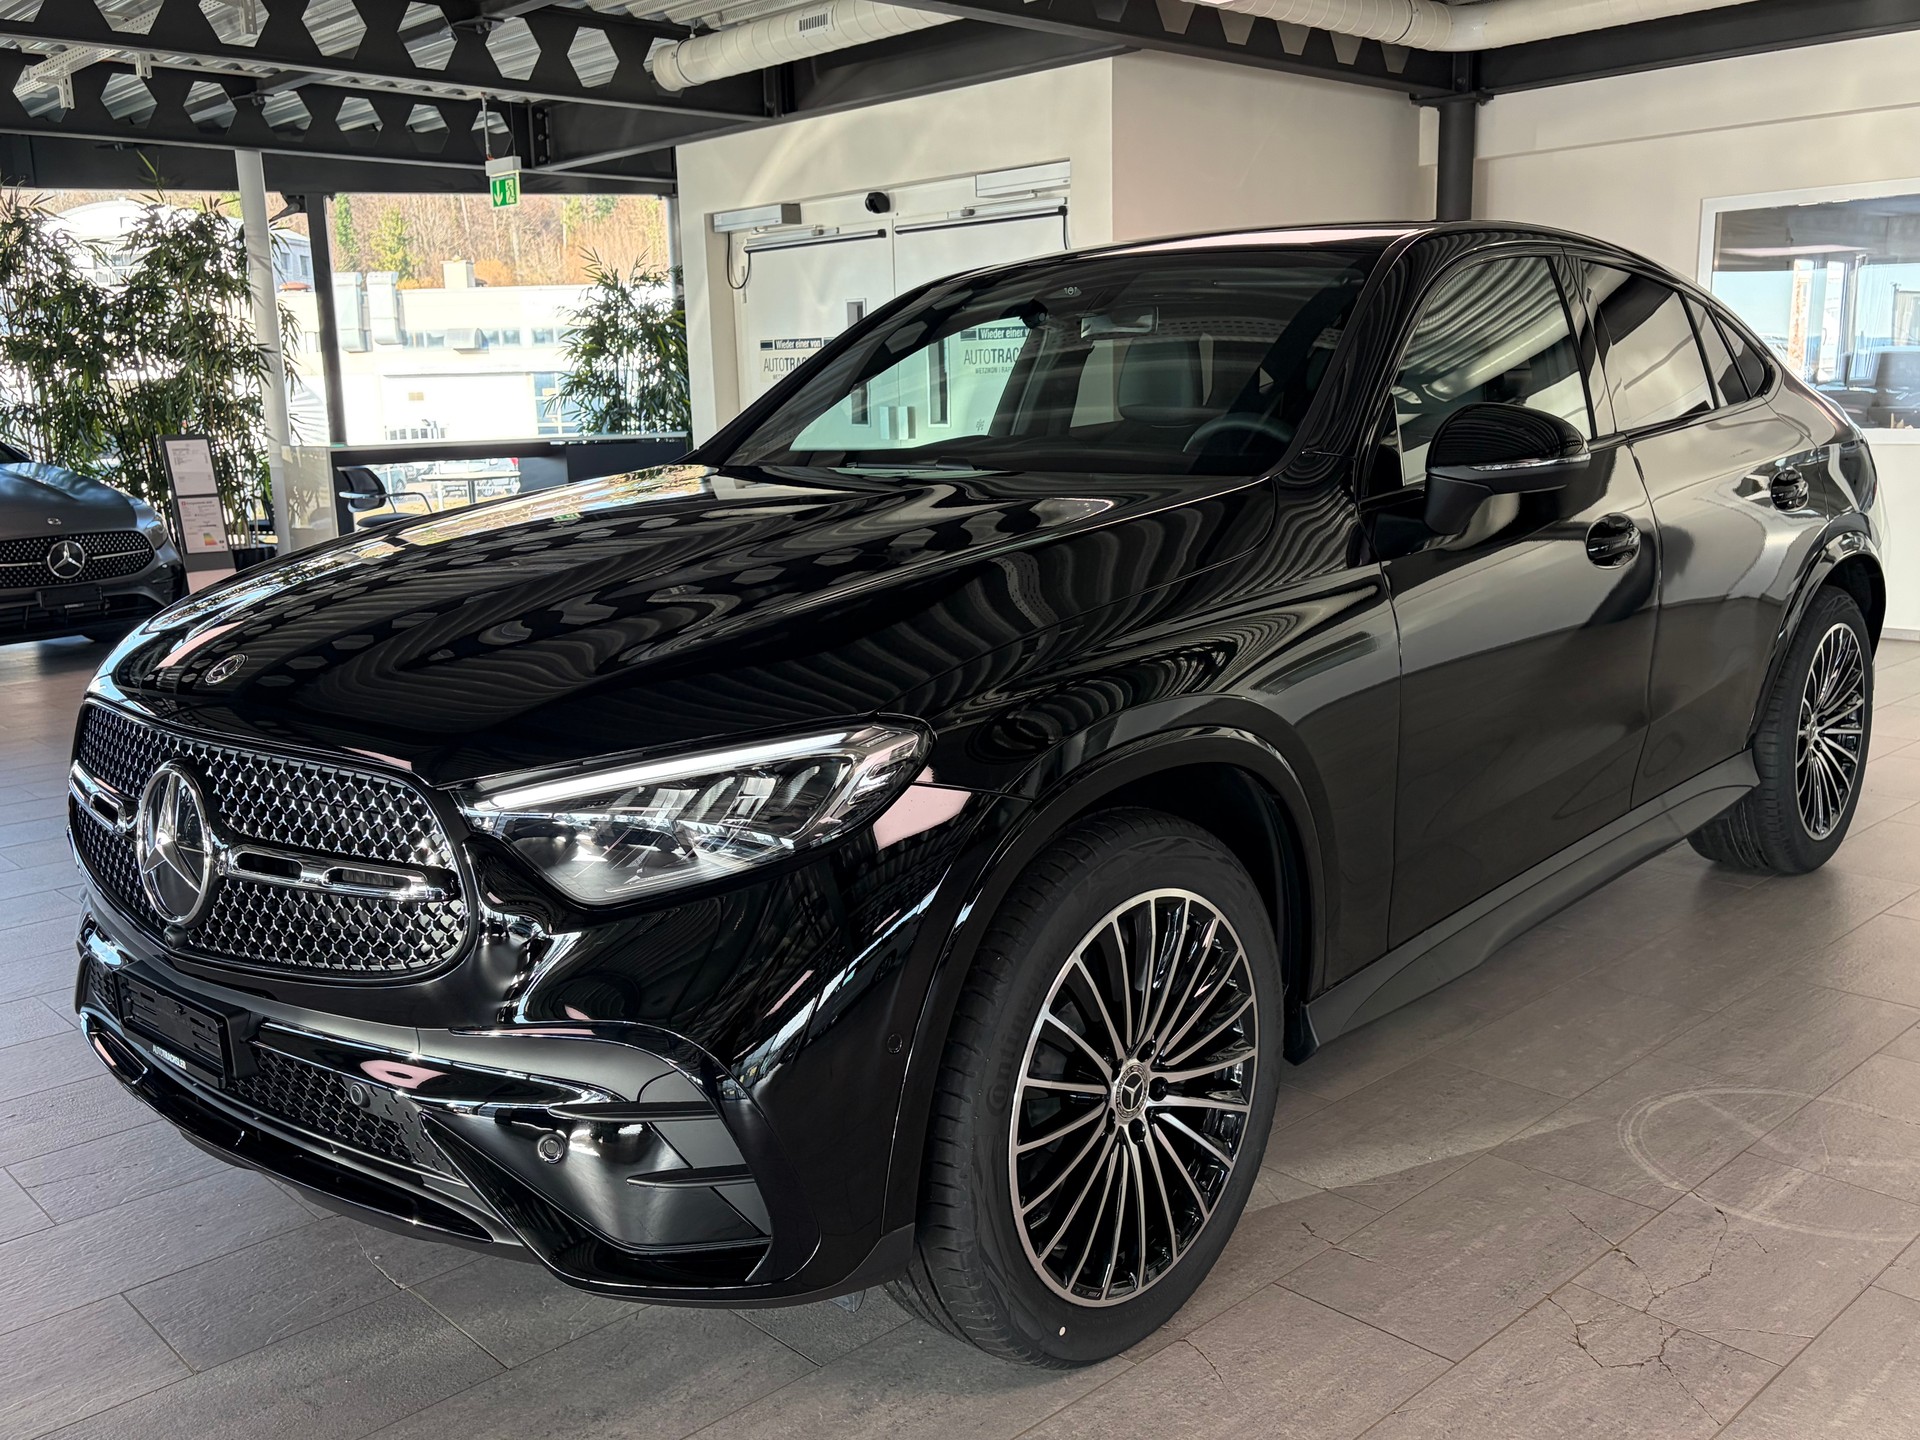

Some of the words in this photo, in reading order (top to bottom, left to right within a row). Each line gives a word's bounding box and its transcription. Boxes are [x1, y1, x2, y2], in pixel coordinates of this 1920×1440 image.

[980, 328, 1005, 339] Wieder
[1005, 327, 1023, 338] einer
[776, 340, 794, 349] Wieder
[795, 340, 809, 349] einer
[810, 340, 820, 348] von
